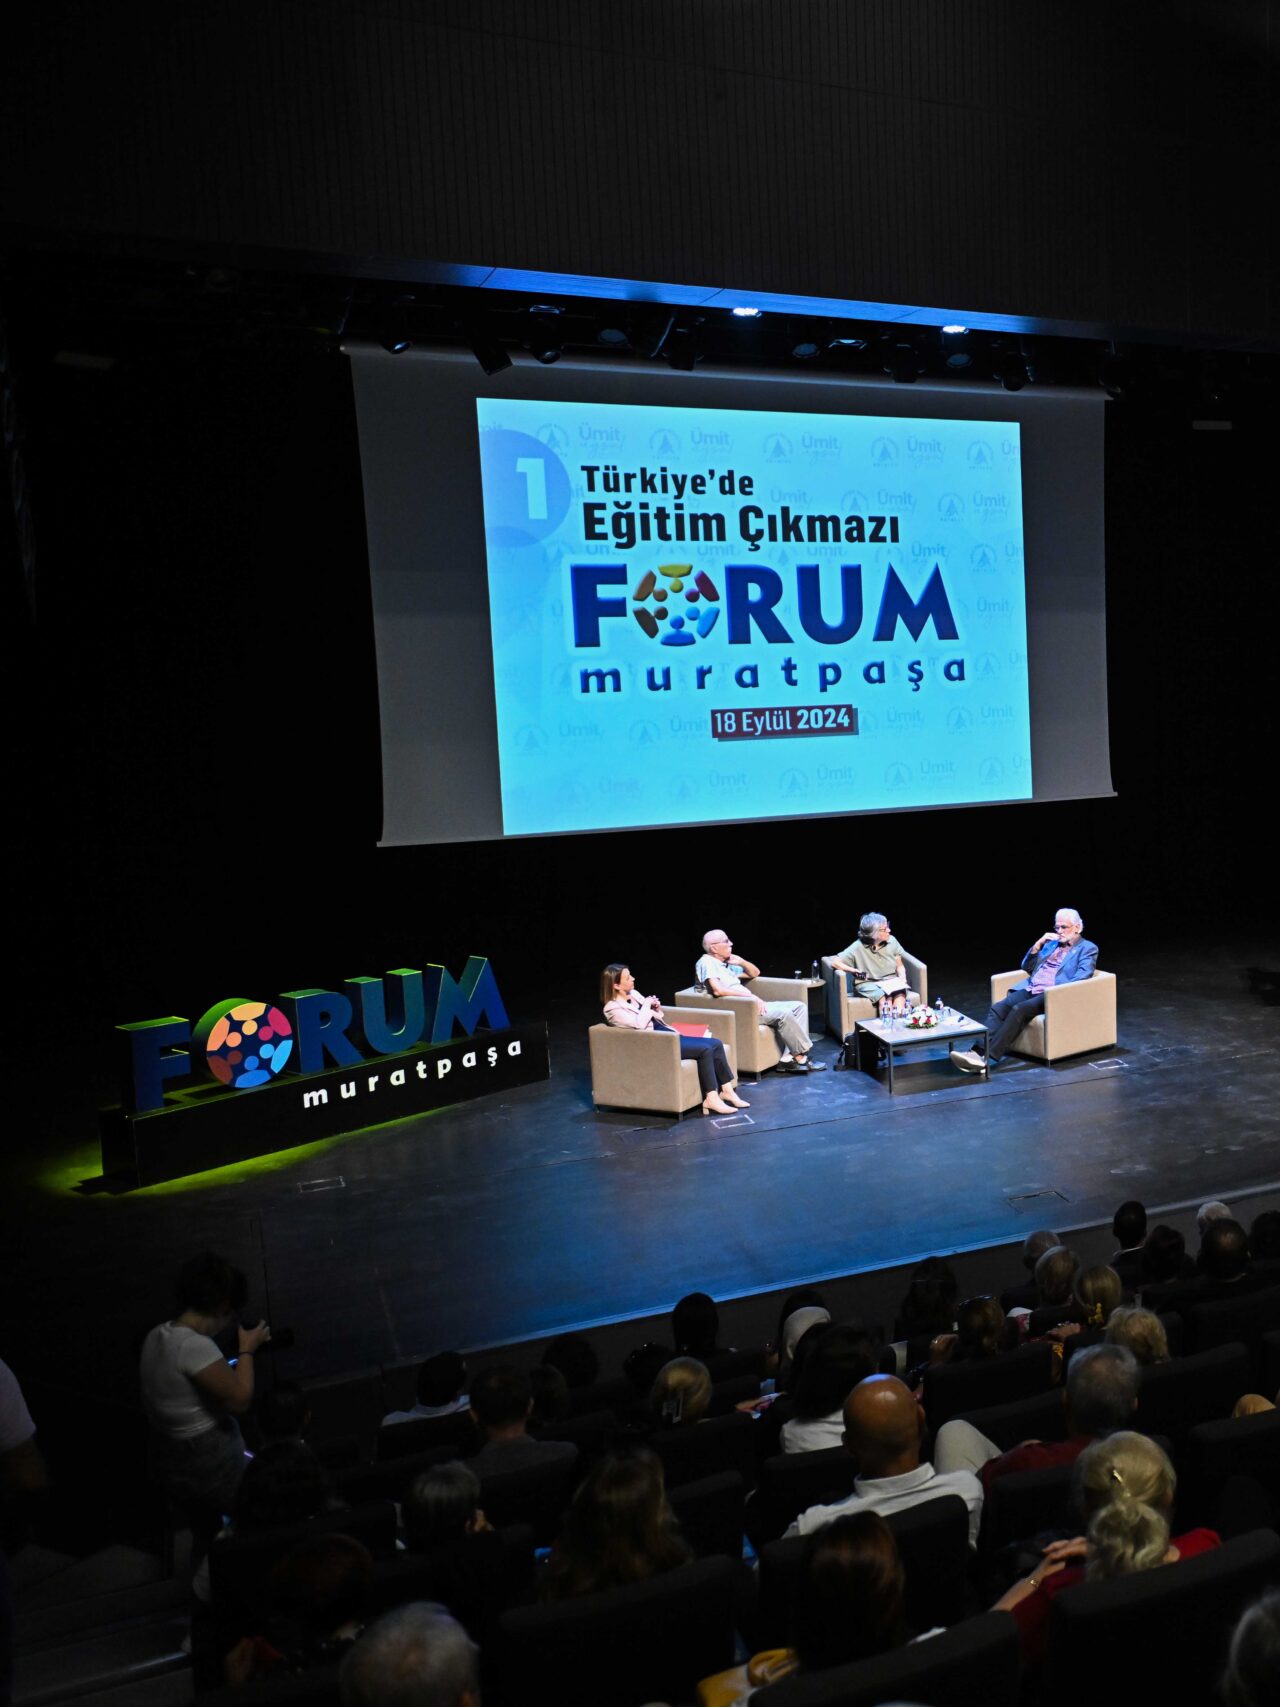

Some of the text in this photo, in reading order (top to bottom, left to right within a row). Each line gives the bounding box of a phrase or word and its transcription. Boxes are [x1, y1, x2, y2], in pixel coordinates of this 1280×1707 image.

[578, 421, 620, 442] Ümit
[690, 427, 730, 446] Ümit
[801, 431, 839, 450] Ümit
[907, 436, 942, 453] Ümit
[516, 457, 548, 520] 1
[580, 465, 754, 500] Türkiye’de
[583, 501, 900, 552] Eğitim Çıkmazı
[570, 562, 960, 648] FORUM
[580, 656, 966, 693] muratpaşa
[715, 707, 850, 736] 18 Eylül 2024
[116, 956, 510, 1113] FORUM
[303, 1038, 522, 1109] muratpaşa
